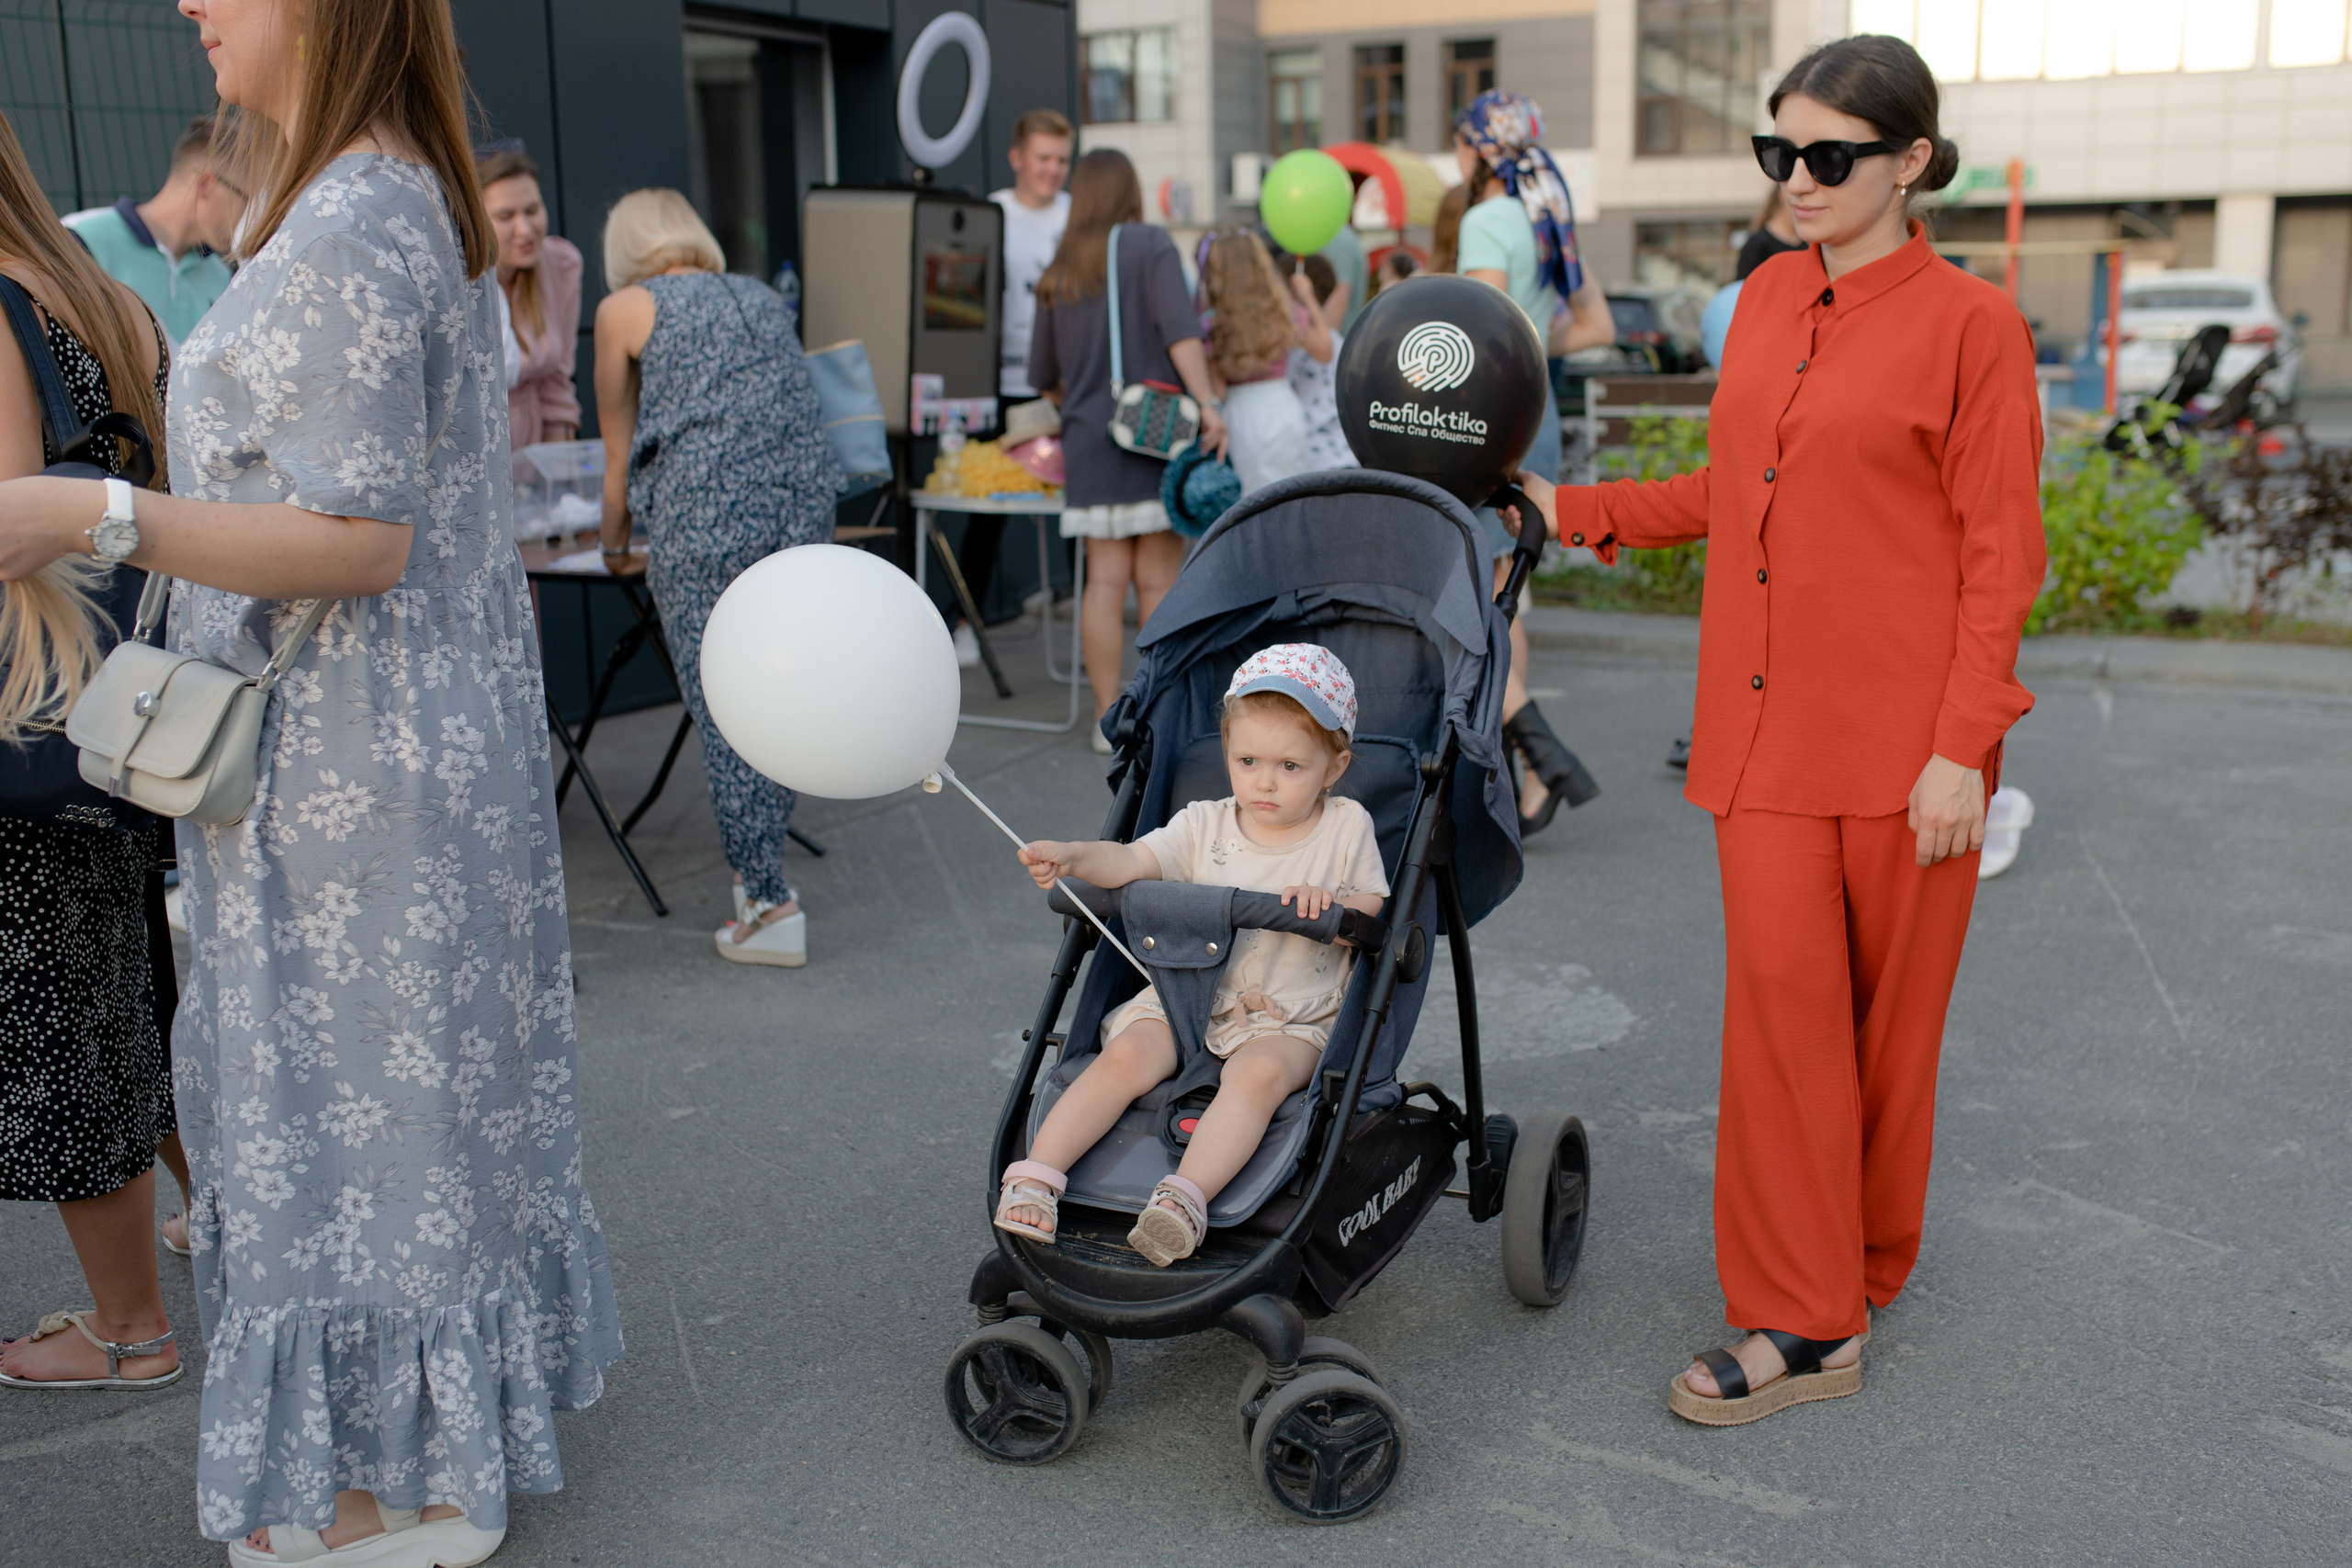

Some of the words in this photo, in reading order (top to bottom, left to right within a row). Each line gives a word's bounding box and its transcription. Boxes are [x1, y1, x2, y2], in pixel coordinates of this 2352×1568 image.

[1368, 419, 1405, 434] Фитнес
[1407, 424, 1429, 437] Спа
[1430, 428, 1486, 446] Общество
[1369, 400, 1488, 435] Profilaktika
[1338, 1192, 1381, 1247] COOL
